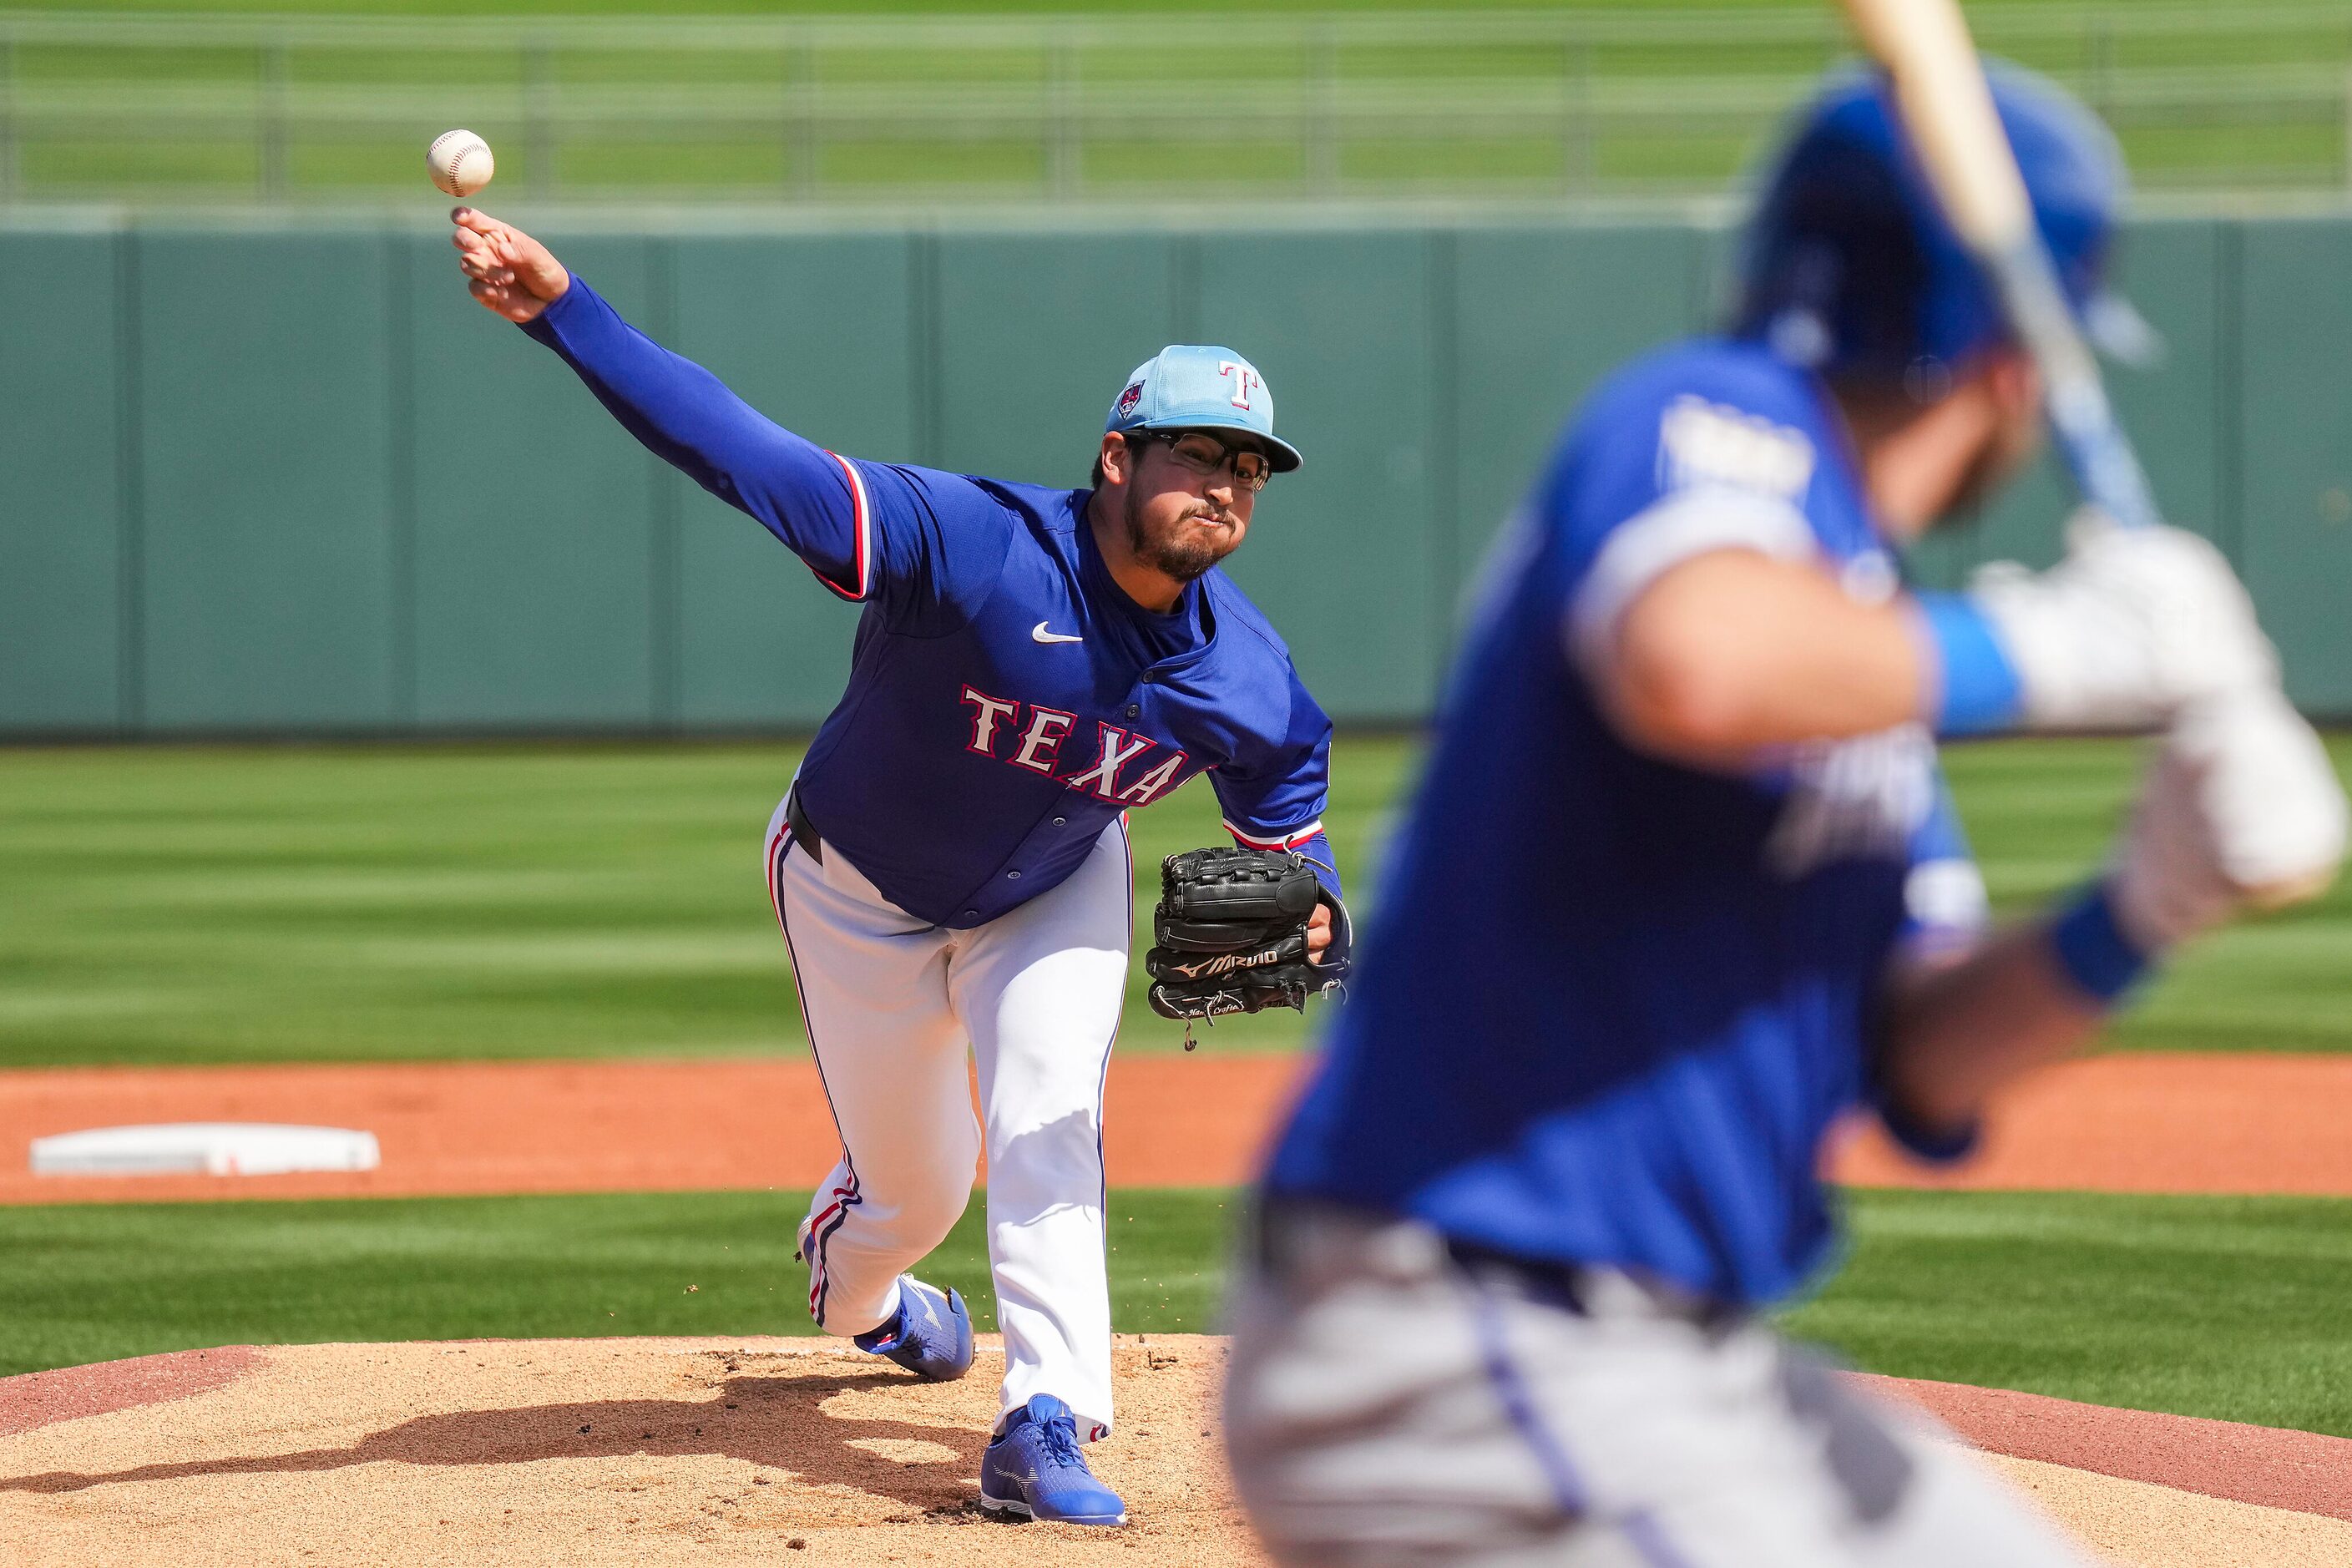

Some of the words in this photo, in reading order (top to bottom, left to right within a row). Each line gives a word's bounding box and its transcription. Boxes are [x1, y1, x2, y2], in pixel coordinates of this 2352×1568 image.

[1217, 360, 1258, 411] T
[960, 683, 1217, 807] TEXA
[1206, 950, 1277, 975] MIZUNO
[1188, 1007, 1206, 1017] Han
